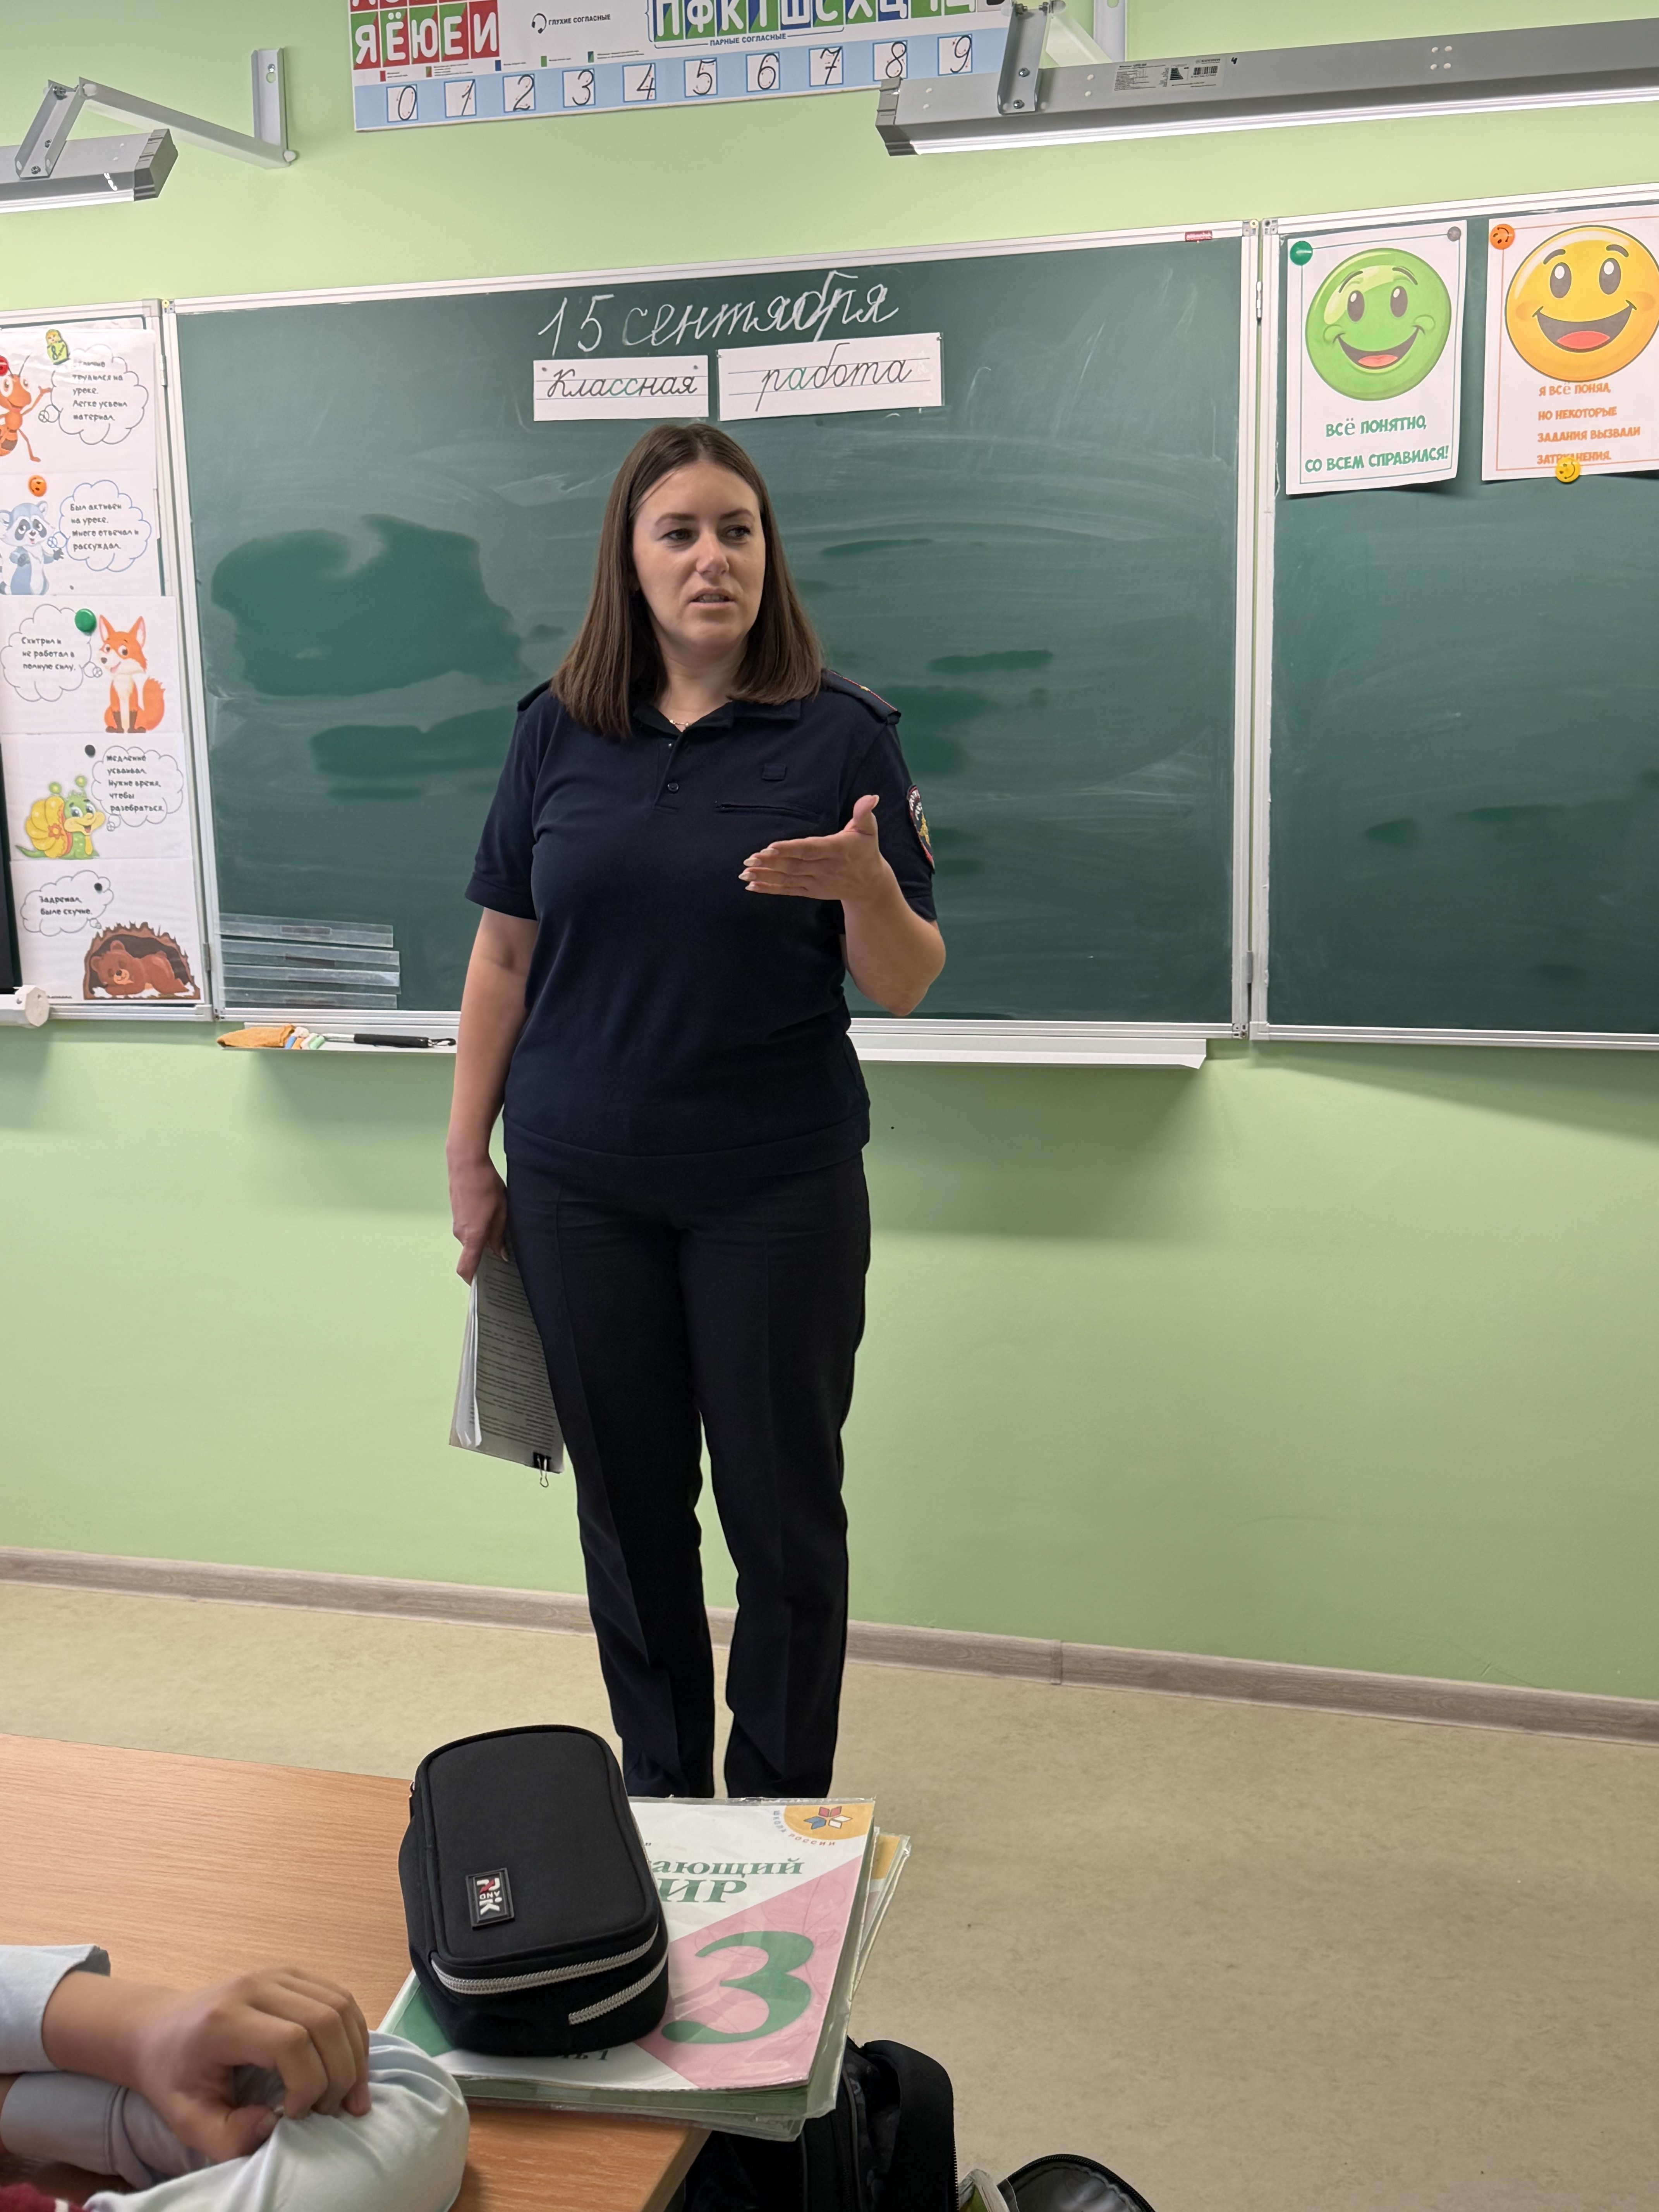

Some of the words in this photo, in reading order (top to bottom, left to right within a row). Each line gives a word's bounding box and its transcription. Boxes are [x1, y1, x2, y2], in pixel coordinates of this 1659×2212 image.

[573, 14, 611, 23] СОГЛАСНЫЕ
[710, 37, 740, 46] ПАРНЫЕ
[742, 33, 787, 43] СОГЛАСНЫЕ
[398, 85, 417, 120] 0
[462, 79, 476, 116] 1
[513, 74, 534, 111] 2
[572, 69, 594, 106] 3
[636, 63, 656, 100] 4
[692, 58, 717, 96] 5
[757, 52, 780, 90] 6
[820, 45, 843, 85] 7
[885, 41, 907, 78] 8
[950, 34, 972, 74] 9
[538, 294, 615, 358] 15
[622, 270, 899, 346] сентября
[547, 368, 698, 398] Классная
[755, 342, 912, 412] работа
[73, 388, 98, 396] уроке.
[1539, 386, 1546, 397] Я
[1575, 383, 1611, 394] ПОНЯЛ,
[99, 401, 127, 409] усвоил
[1538, 410, 1553, 421] НО
[1555, 406, 1618, 420] НЕКОТОРЫЕ
[1360, 415, 1427, 434] ПОНЯТНО,
[1537, 430, 1587, 443] ЗАДАНИЯ
[1590, 426, 1640, 440] ВЫЗВАЛИ
[1305, 459, 1322, 472] СО
[1326, 455, 1365, 471] ВСЕМ
[1368, 445, 1449, 467] СПРАВИЛСЯ!
[82, 517, 109, 526] уроке.
[73, 543, 121, 552] рассуждал.
[21, 636, 55, 646] Схитрил
[33, 650, 69, 659] работал
[23, 663, 53, 672] полную
[55, 664, 76, 672] силу.
[108, 780, 133, 788] Нужно
[788, 1833, 835, 1846] РОССИИ
[652, 1858, 805, 1878] ающий
[661, 1930, 814, 2045] 3
